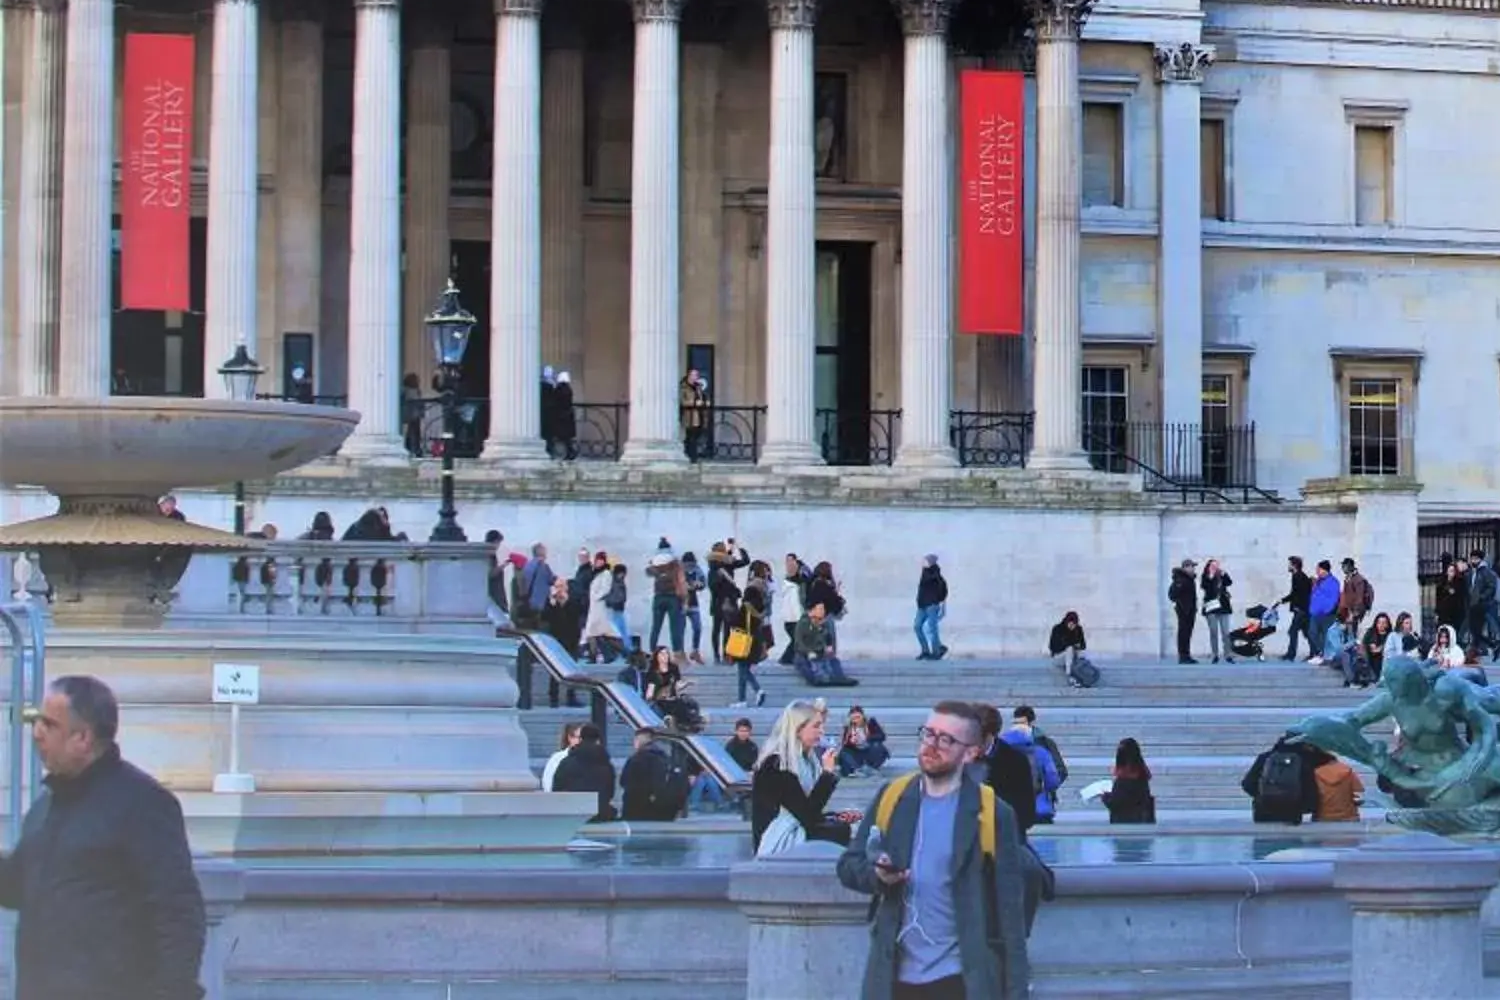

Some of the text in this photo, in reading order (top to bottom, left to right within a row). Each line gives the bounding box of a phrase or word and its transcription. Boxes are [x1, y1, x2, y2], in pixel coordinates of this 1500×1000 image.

[142, 78, 161, 206] NATIONAL
[162, 80, 183, 207] GALLERY
[979, 113, 995, 233] NATIONAL
[997, 113, 1014, 235] GALLERY
